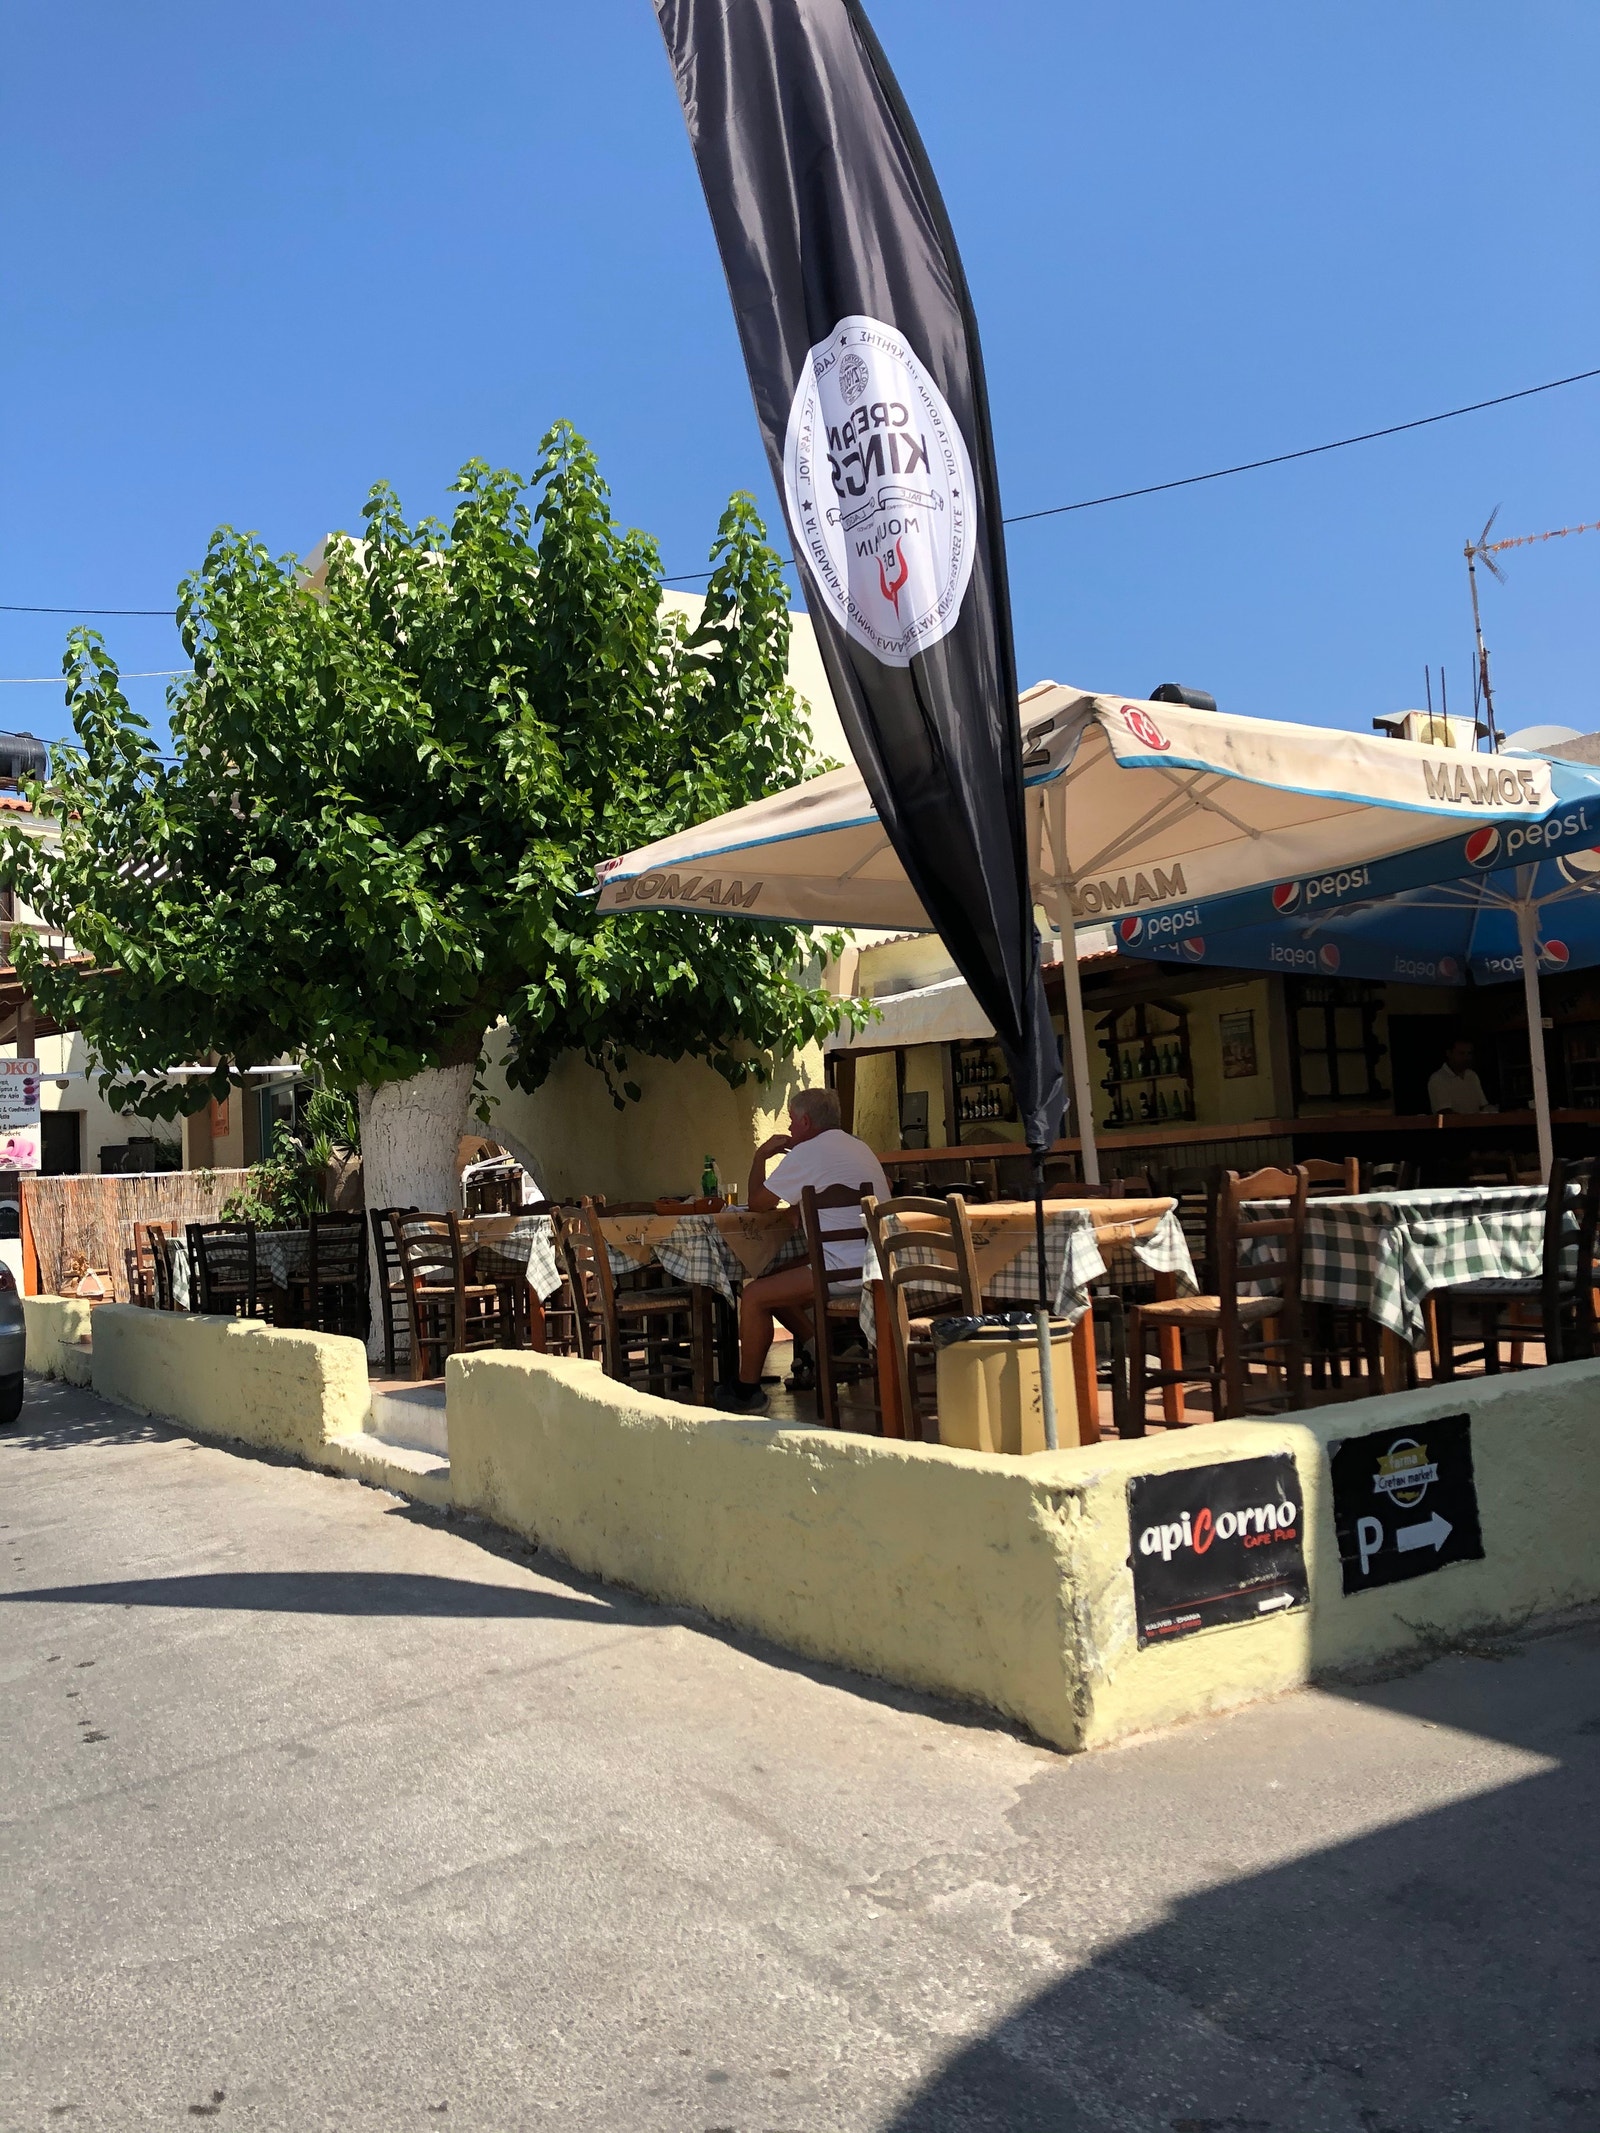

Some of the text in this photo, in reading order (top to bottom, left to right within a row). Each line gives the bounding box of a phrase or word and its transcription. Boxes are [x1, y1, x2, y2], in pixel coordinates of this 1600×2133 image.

[1507, 806, 1589, 857] pepsi
[1305, 865, 1370, 903] pepsi
[1148, 905, 1203, 940] pepsi
[1408, 1469, 1434, 1484] market
[1357, 1516, 1384, 1575] P
